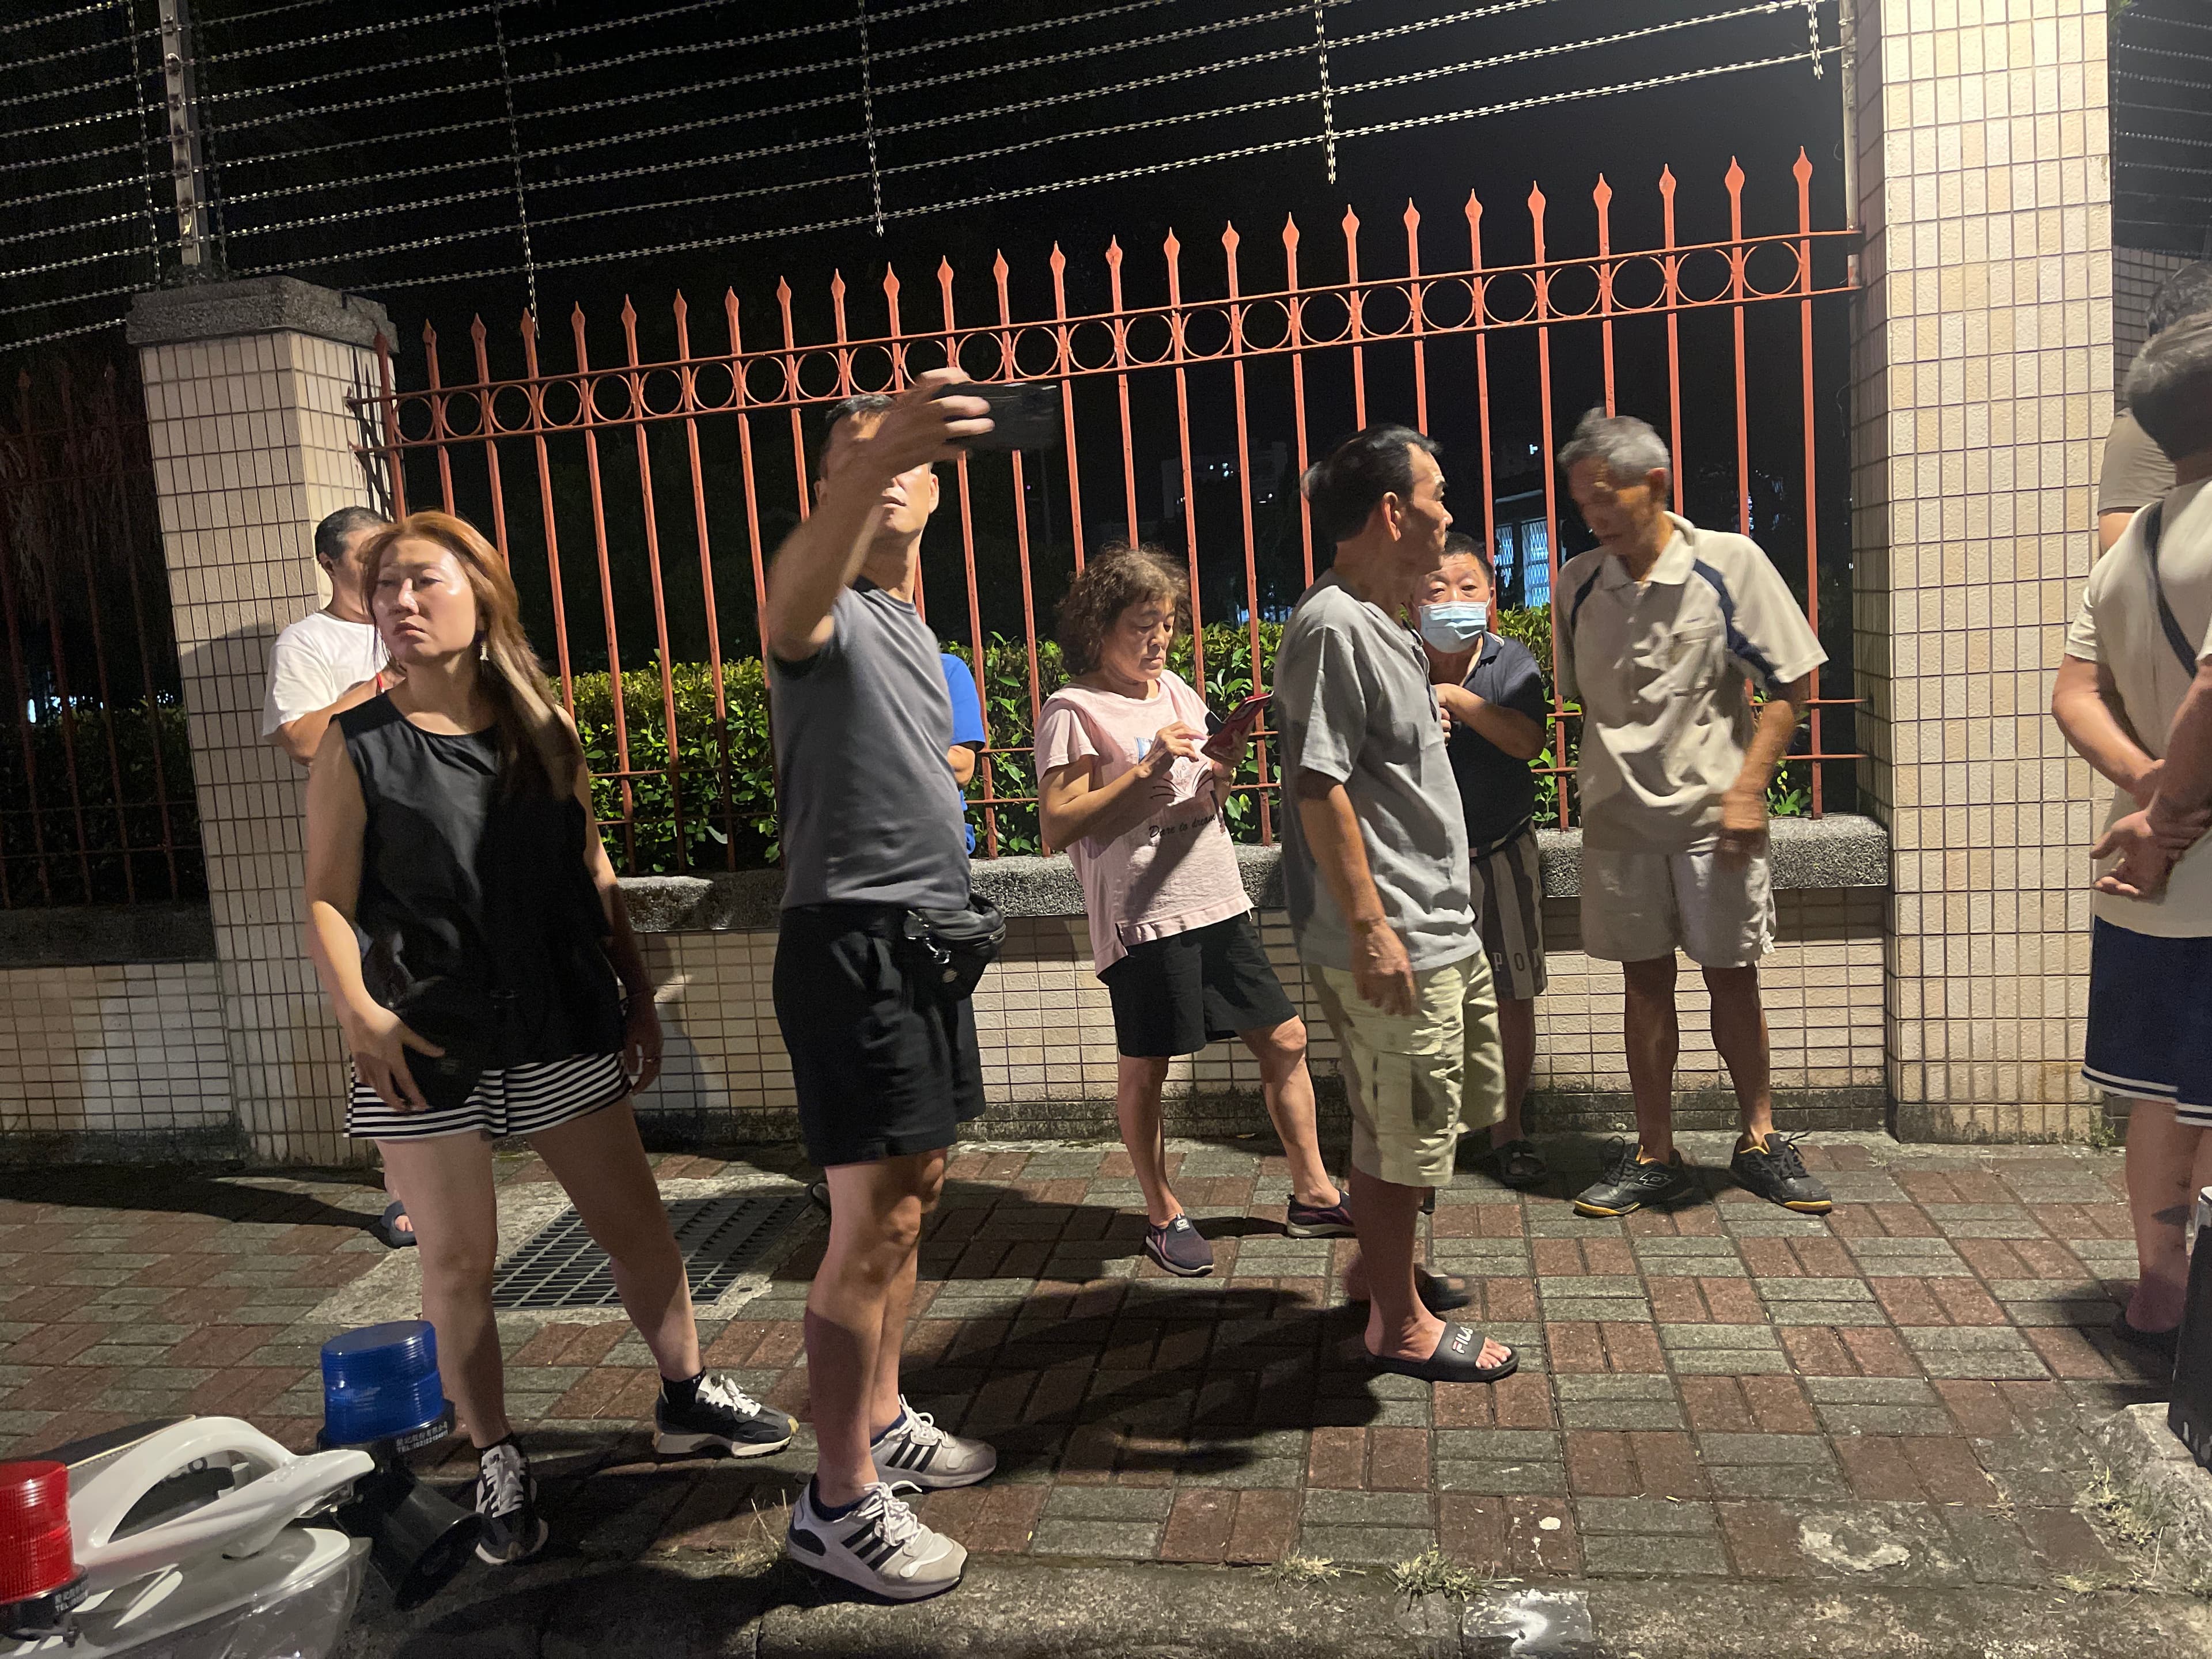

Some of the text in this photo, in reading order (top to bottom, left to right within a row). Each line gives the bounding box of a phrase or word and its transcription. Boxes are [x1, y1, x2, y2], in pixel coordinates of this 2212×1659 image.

[1149, 825, 1175, 838] Dare
[1179, 822, 1188, 832] to
[1452, 1326, 1473, 1354] FILA
